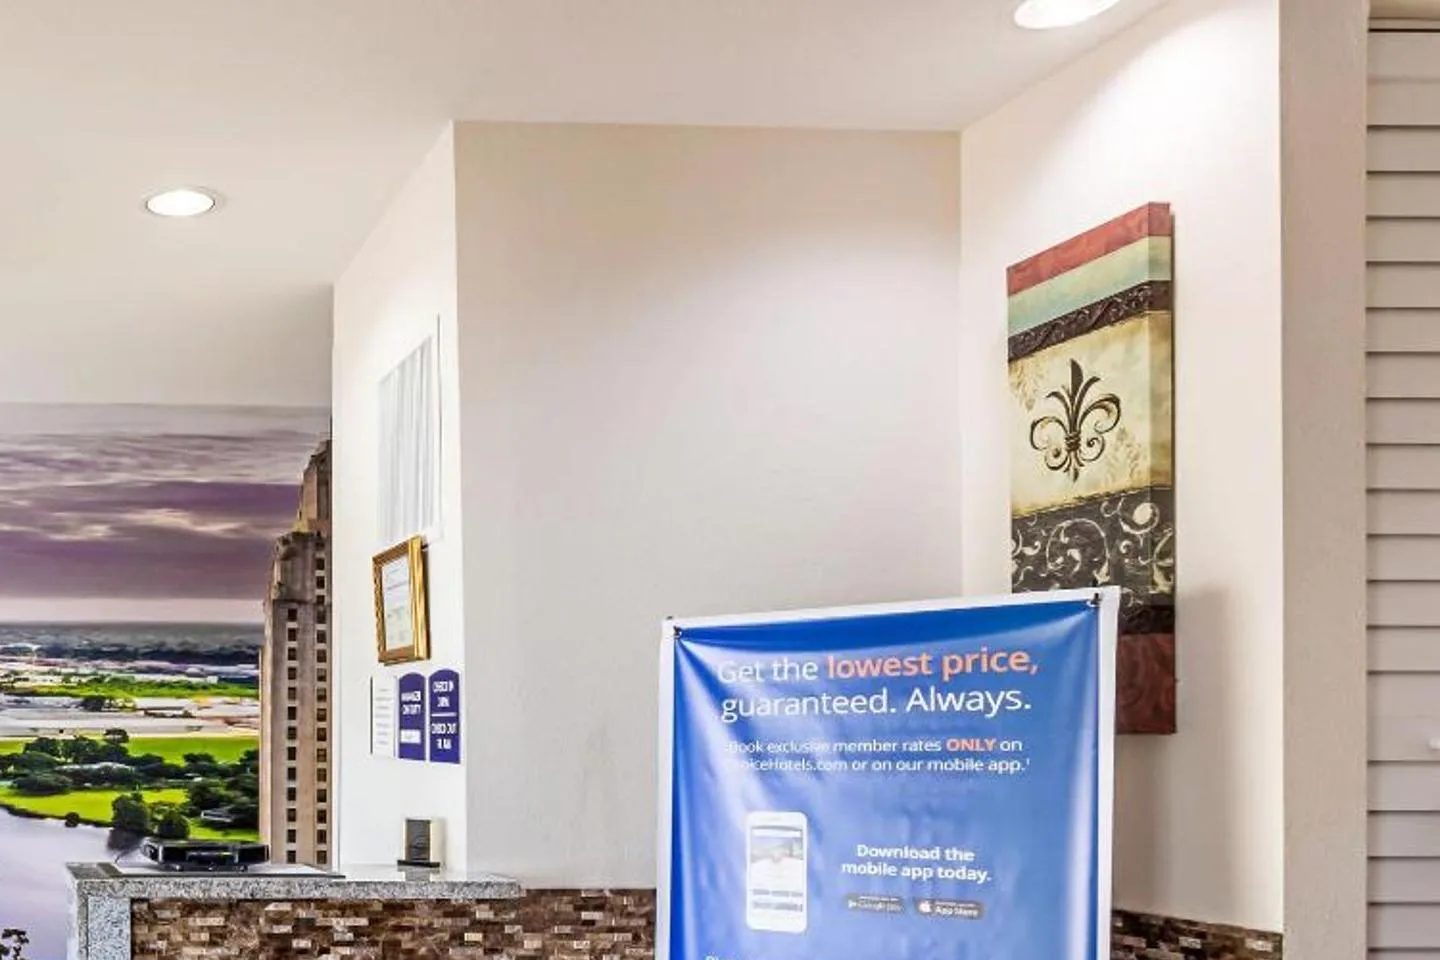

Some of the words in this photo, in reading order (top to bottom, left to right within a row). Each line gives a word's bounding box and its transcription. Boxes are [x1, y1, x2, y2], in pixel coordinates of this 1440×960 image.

[718, 660, 764, 684] Get
[772, 657, 818, 682] the
[827, 652, 932, 679] lowest
[942, 646, 1040, 682] price,
[722, 688, 896, 722] guaranteed.
[906, 686, 1032, 717] Always.
[833, 739, 897, 752] member
[902, 740, 941, 752] rates
[946, 738, 995, 752] ONLY
[999, 741, 1023, 752] on
[852, 759, 867, 771] or
[871, 760, 892, 771] on
[896, 760, 923, 771] our
[927, 758, 984, 772] mobile
[857, 844, 941, 861] Download
[945, 847, 975, 861] the
[841, 861, 897, 877] mobile
[900, 866, 933, 881] app
[937, 867, 992, 884] today.
